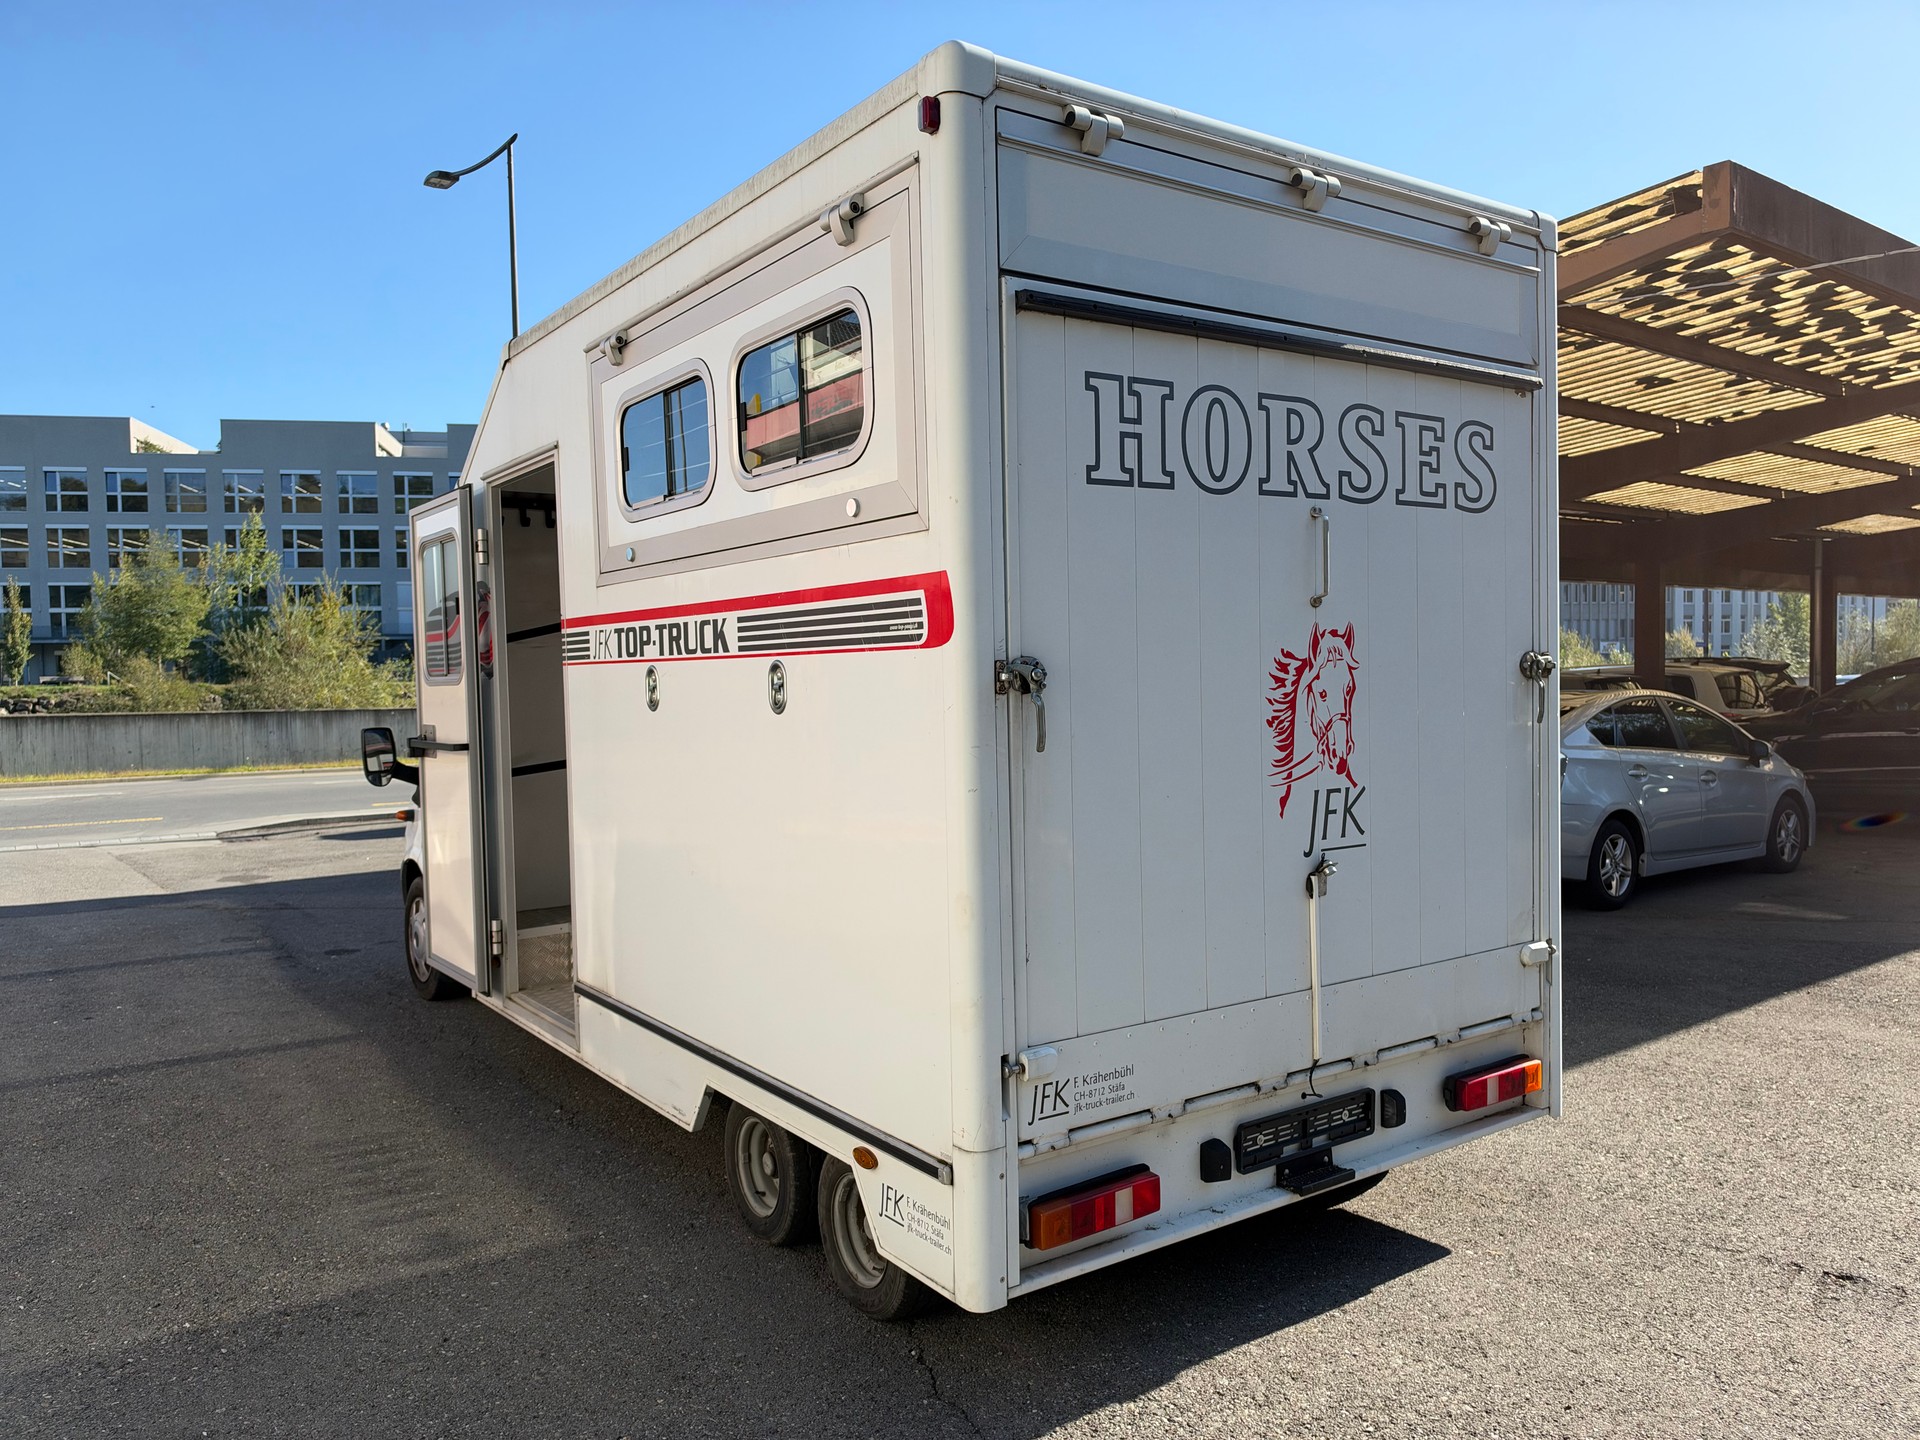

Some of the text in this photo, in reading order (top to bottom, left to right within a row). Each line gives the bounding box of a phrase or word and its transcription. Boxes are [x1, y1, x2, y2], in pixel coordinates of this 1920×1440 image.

[1084, 370, 1498, 514] HORSES
[593, 629, 613, 660] JFK
[1303, 786, 1367, 858] JFK
[1073, 1064, 1134, 1089] F. Krähenbühl
[1073, 1082, 1126, 1102] CH-8712 Stäfa
[1028, 1078, 1071, 1126] JFK
[1073, 1091, 1135, 1115] jfk-truck-trailer.ch
[879, 1183, 905, 1222] JFK
[912, 1199, 951, 1231] Krähenbühl
[906, 1211, 944, 1240] CH-8712 Stäfa
[906, 1223, 952, 1256] jfk-truck-trailer.ch
